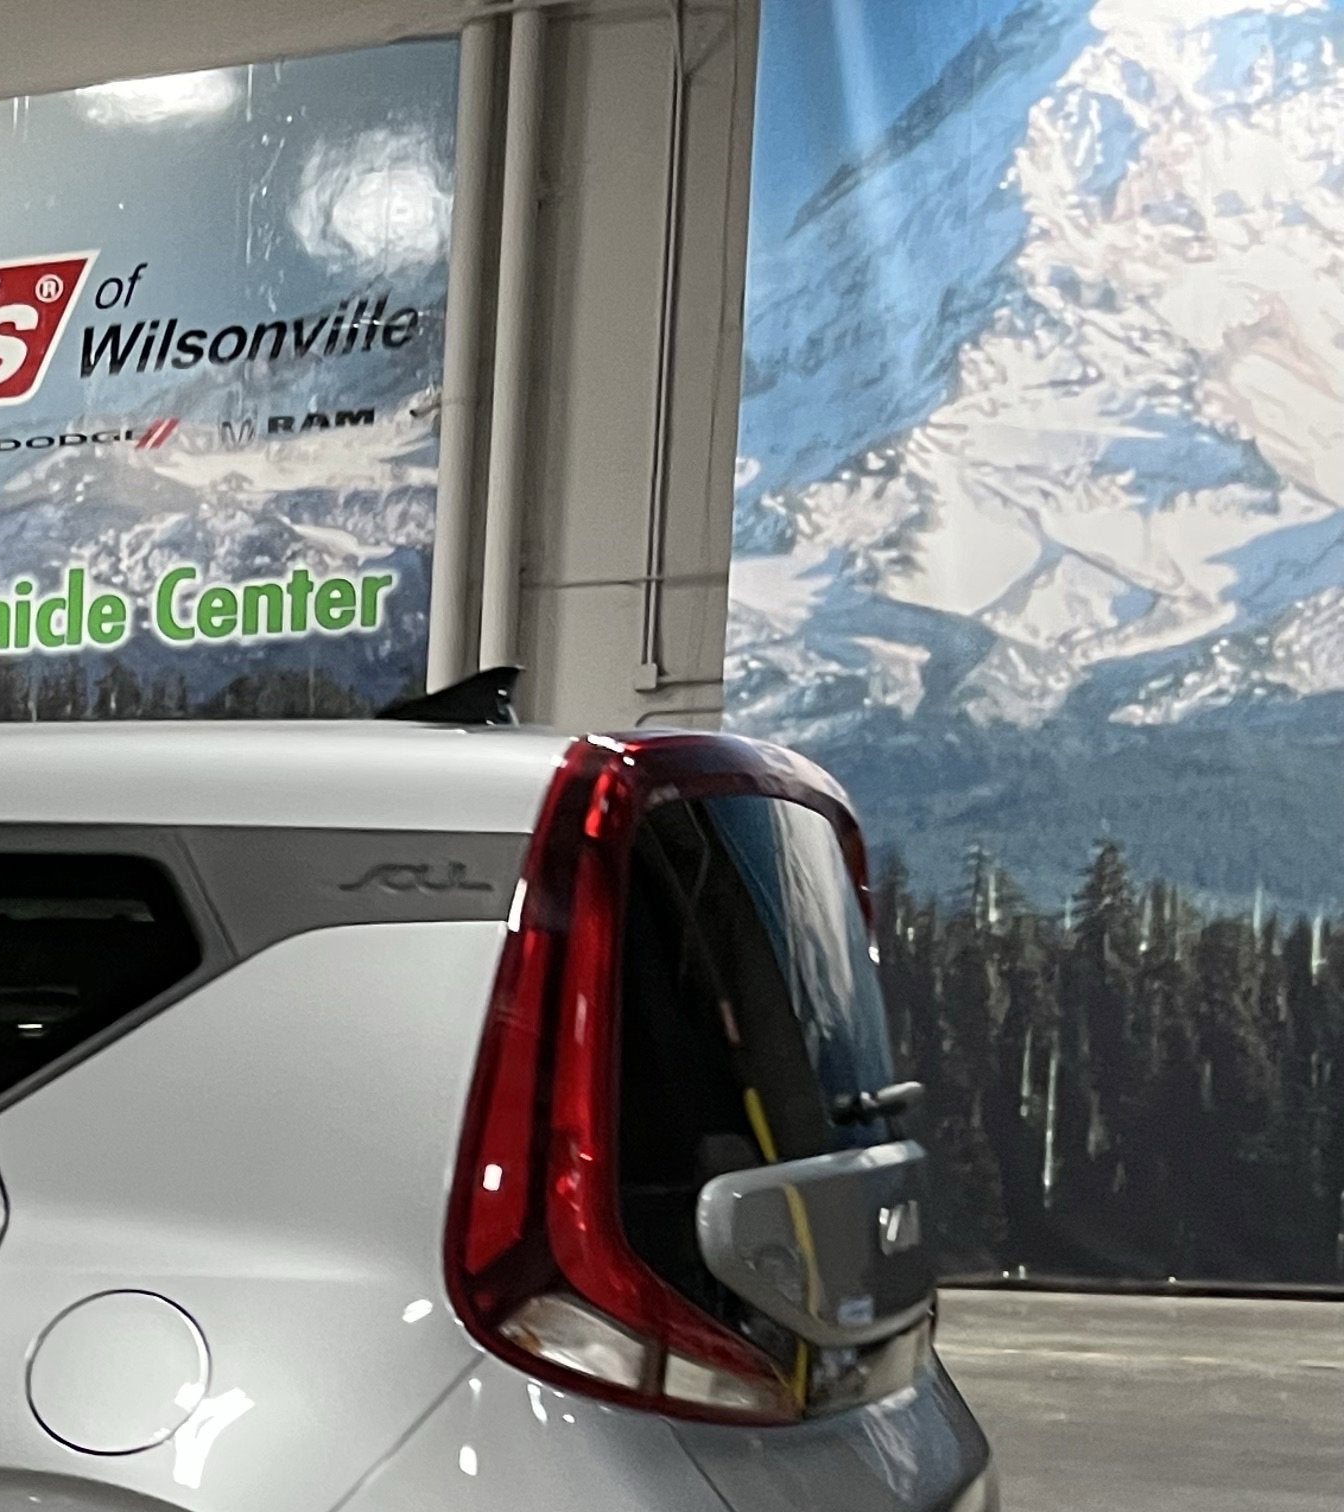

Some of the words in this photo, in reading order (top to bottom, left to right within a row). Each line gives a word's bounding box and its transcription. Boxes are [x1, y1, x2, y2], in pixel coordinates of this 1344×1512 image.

[95, 262, 147, 310] of
[80, 288, 419, 379] Wilsonville
[267, 408, 375, 435] RAM
[156, 566, 393, 641] Center
